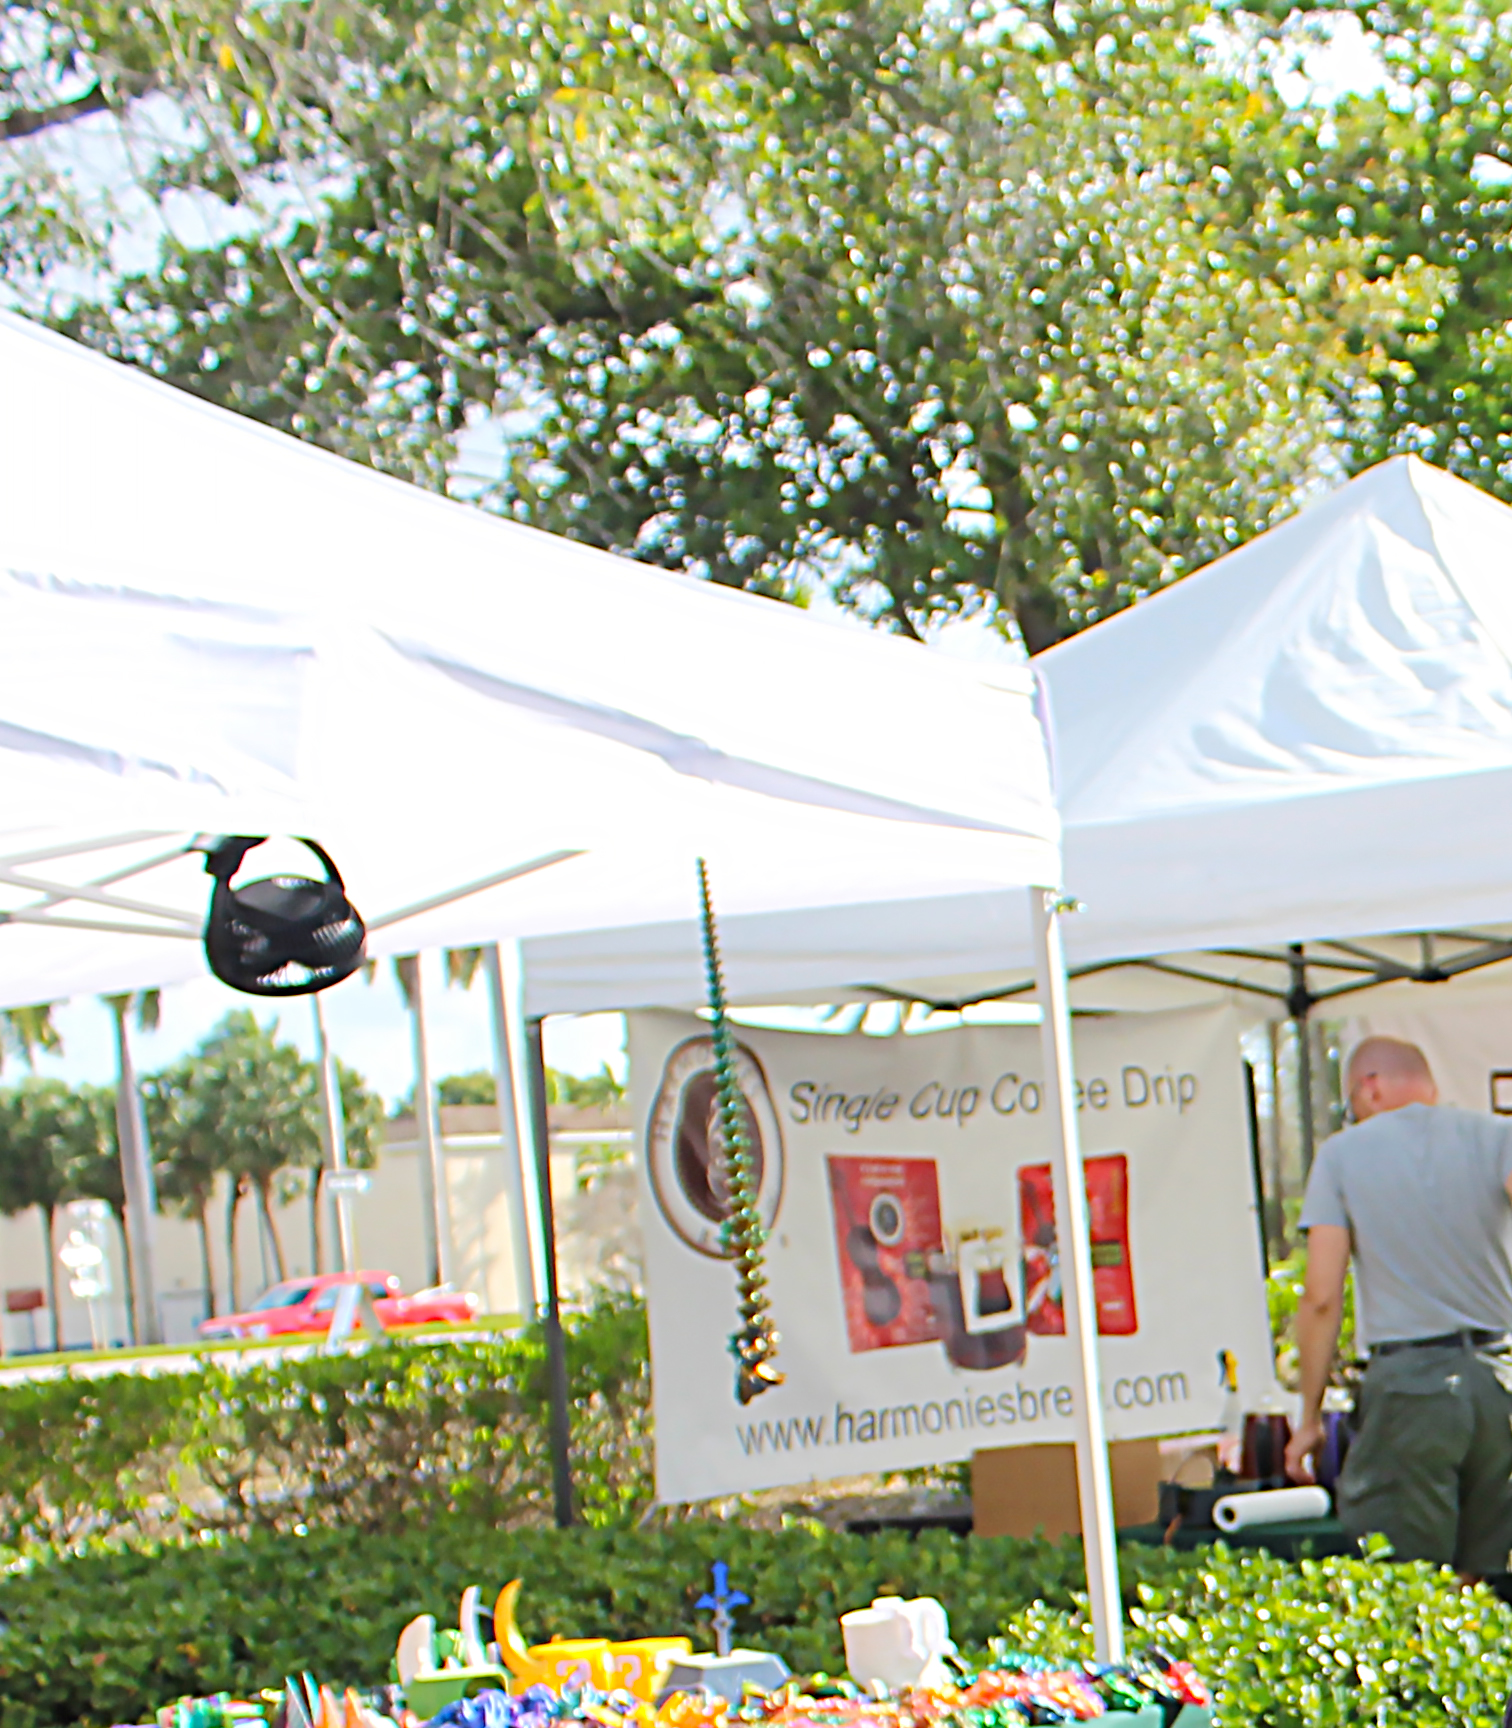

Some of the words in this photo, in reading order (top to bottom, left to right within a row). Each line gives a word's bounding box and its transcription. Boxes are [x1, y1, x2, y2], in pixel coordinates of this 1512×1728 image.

[789, 1079, 901, 1134] Single
[908, 1080, 981, 1128] Cup
[989, 1072, 1110, 1115] Coee
[1121, 1064, 1199, 1115] Drip
[735, 1371, 1190, 1457] www.harmoniesbre.com
